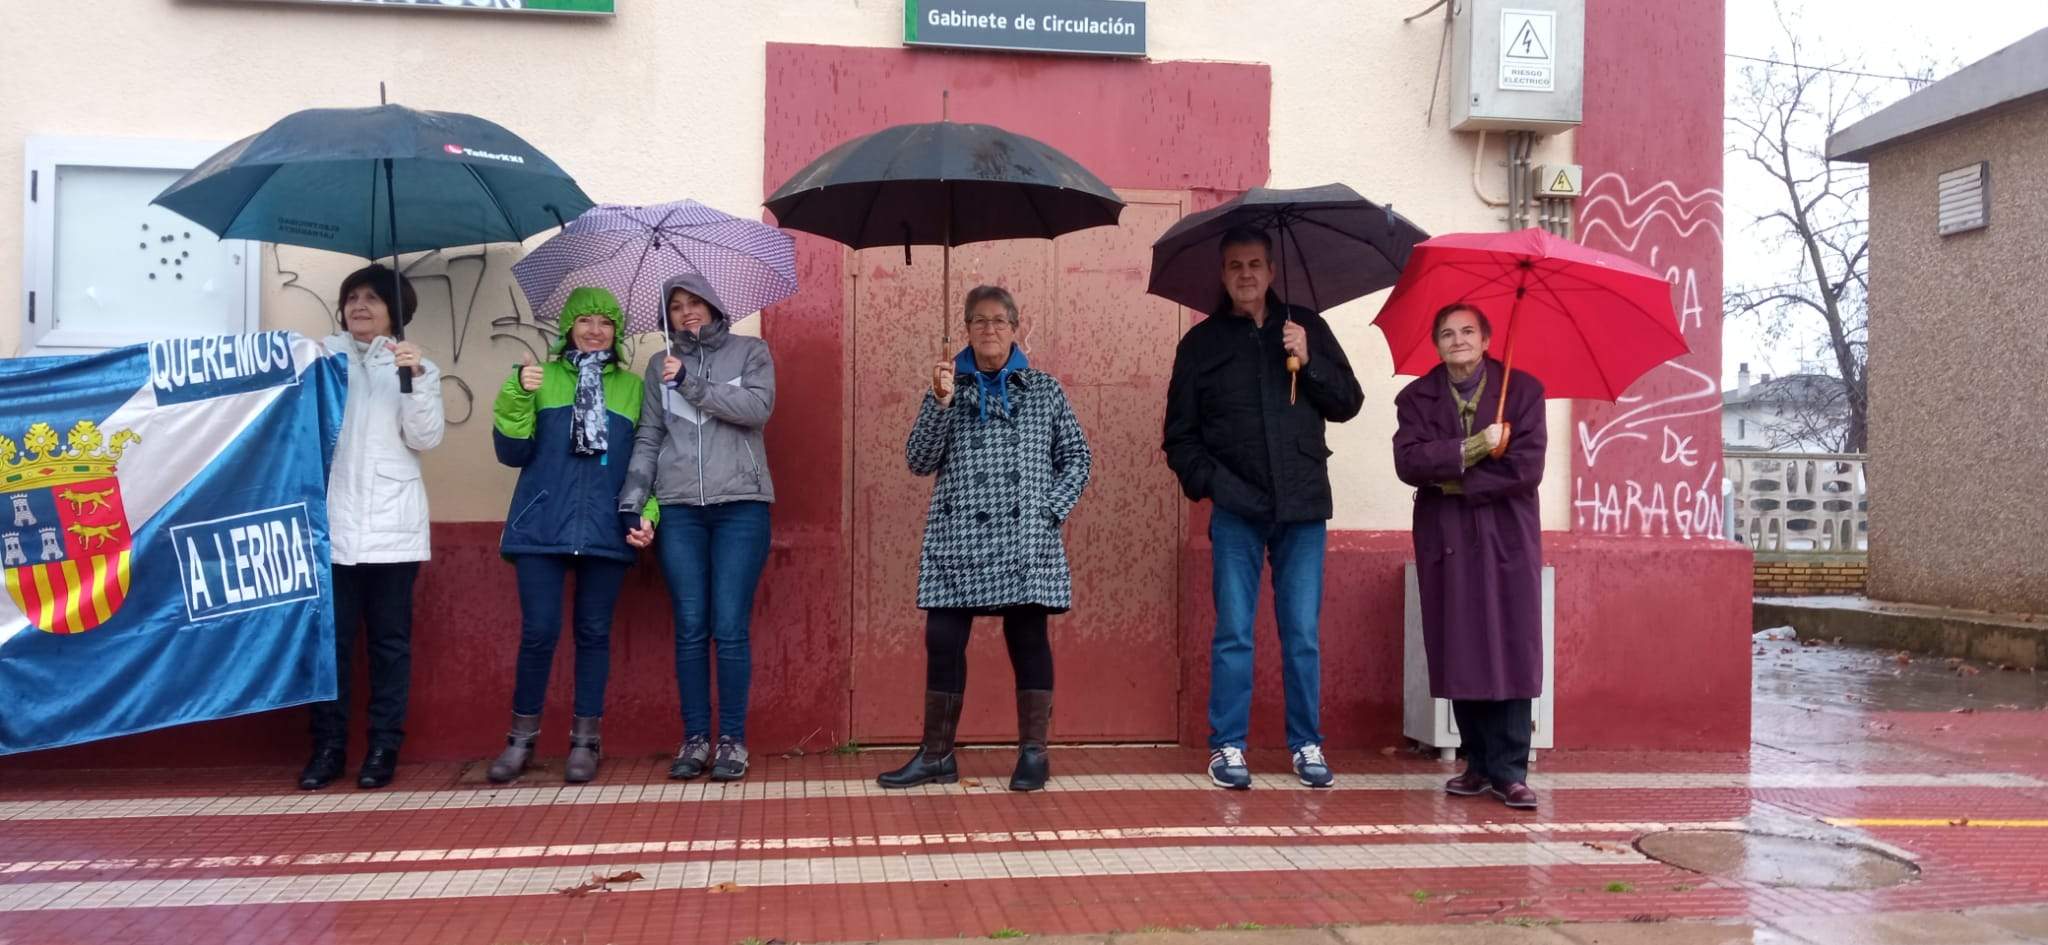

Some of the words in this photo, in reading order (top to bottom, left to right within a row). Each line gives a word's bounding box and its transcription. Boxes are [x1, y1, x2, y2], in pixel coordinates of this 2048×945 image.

[928, 9, 1007, 30] Gabinete
[1014, 14, 1036, 31] de
[1043, 15, 1135, 36] Circulación
[1511, 69, 1542, 77] RIESGO
[151, 330, 290, 392] QUEREMOS
[1661, 425, 1698, 466] DE
[1574, 461, 1725, 539] HARAGÓN
[187, 536, 213, 610] A
[213, 517, 312, 603] LERIDA
